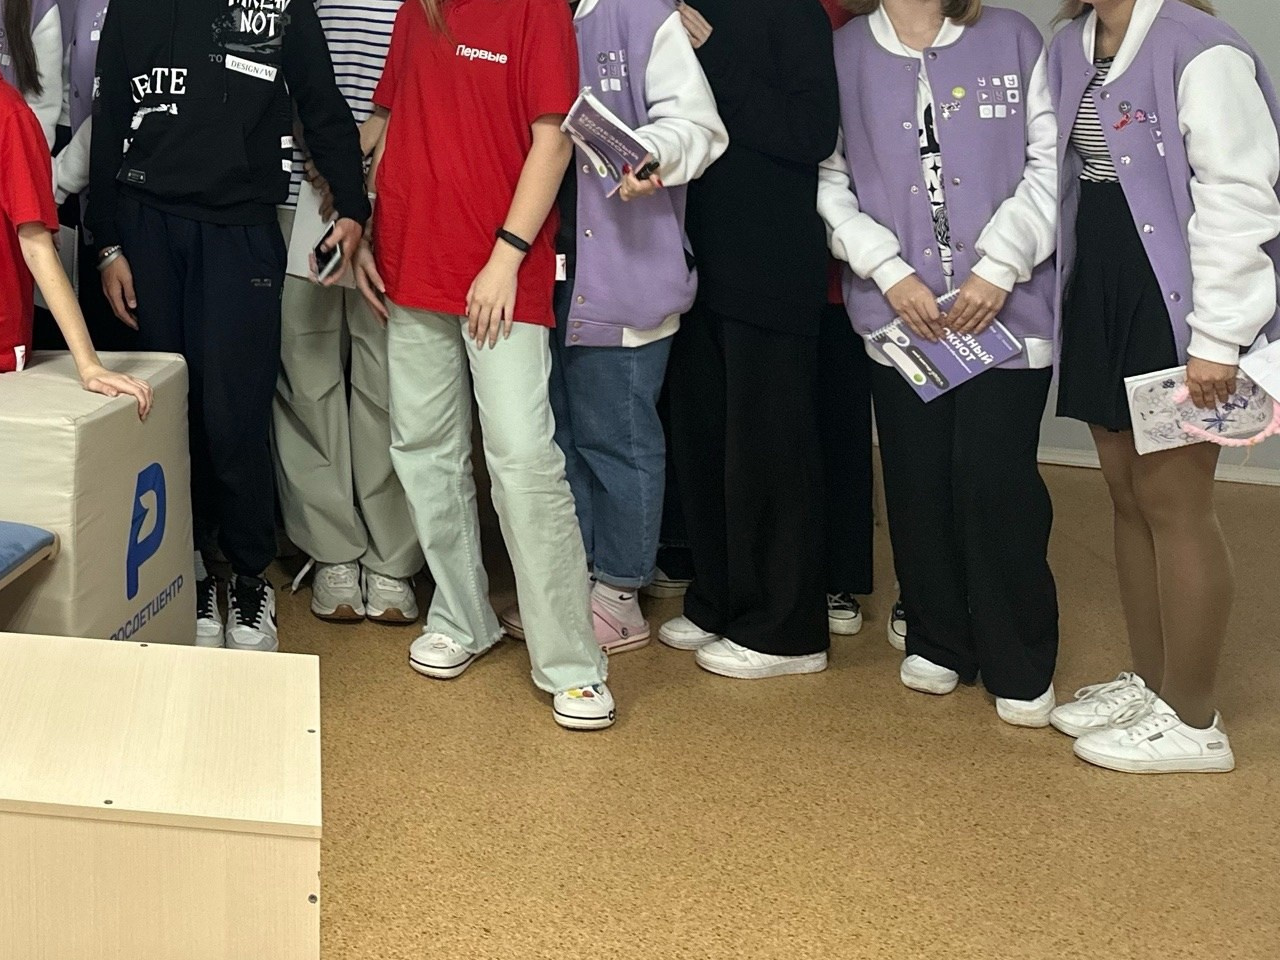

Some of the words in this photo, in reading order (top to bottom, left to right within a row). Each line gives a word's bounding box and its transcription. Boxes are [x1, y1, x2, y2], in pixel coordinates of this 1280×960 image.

[240, 9, 279, 37] NOT
[208, 54, 223, 63] TO
[455, 44, 508, 64] Первые
[960, 333, 994, 365] ЗНЫЙ
